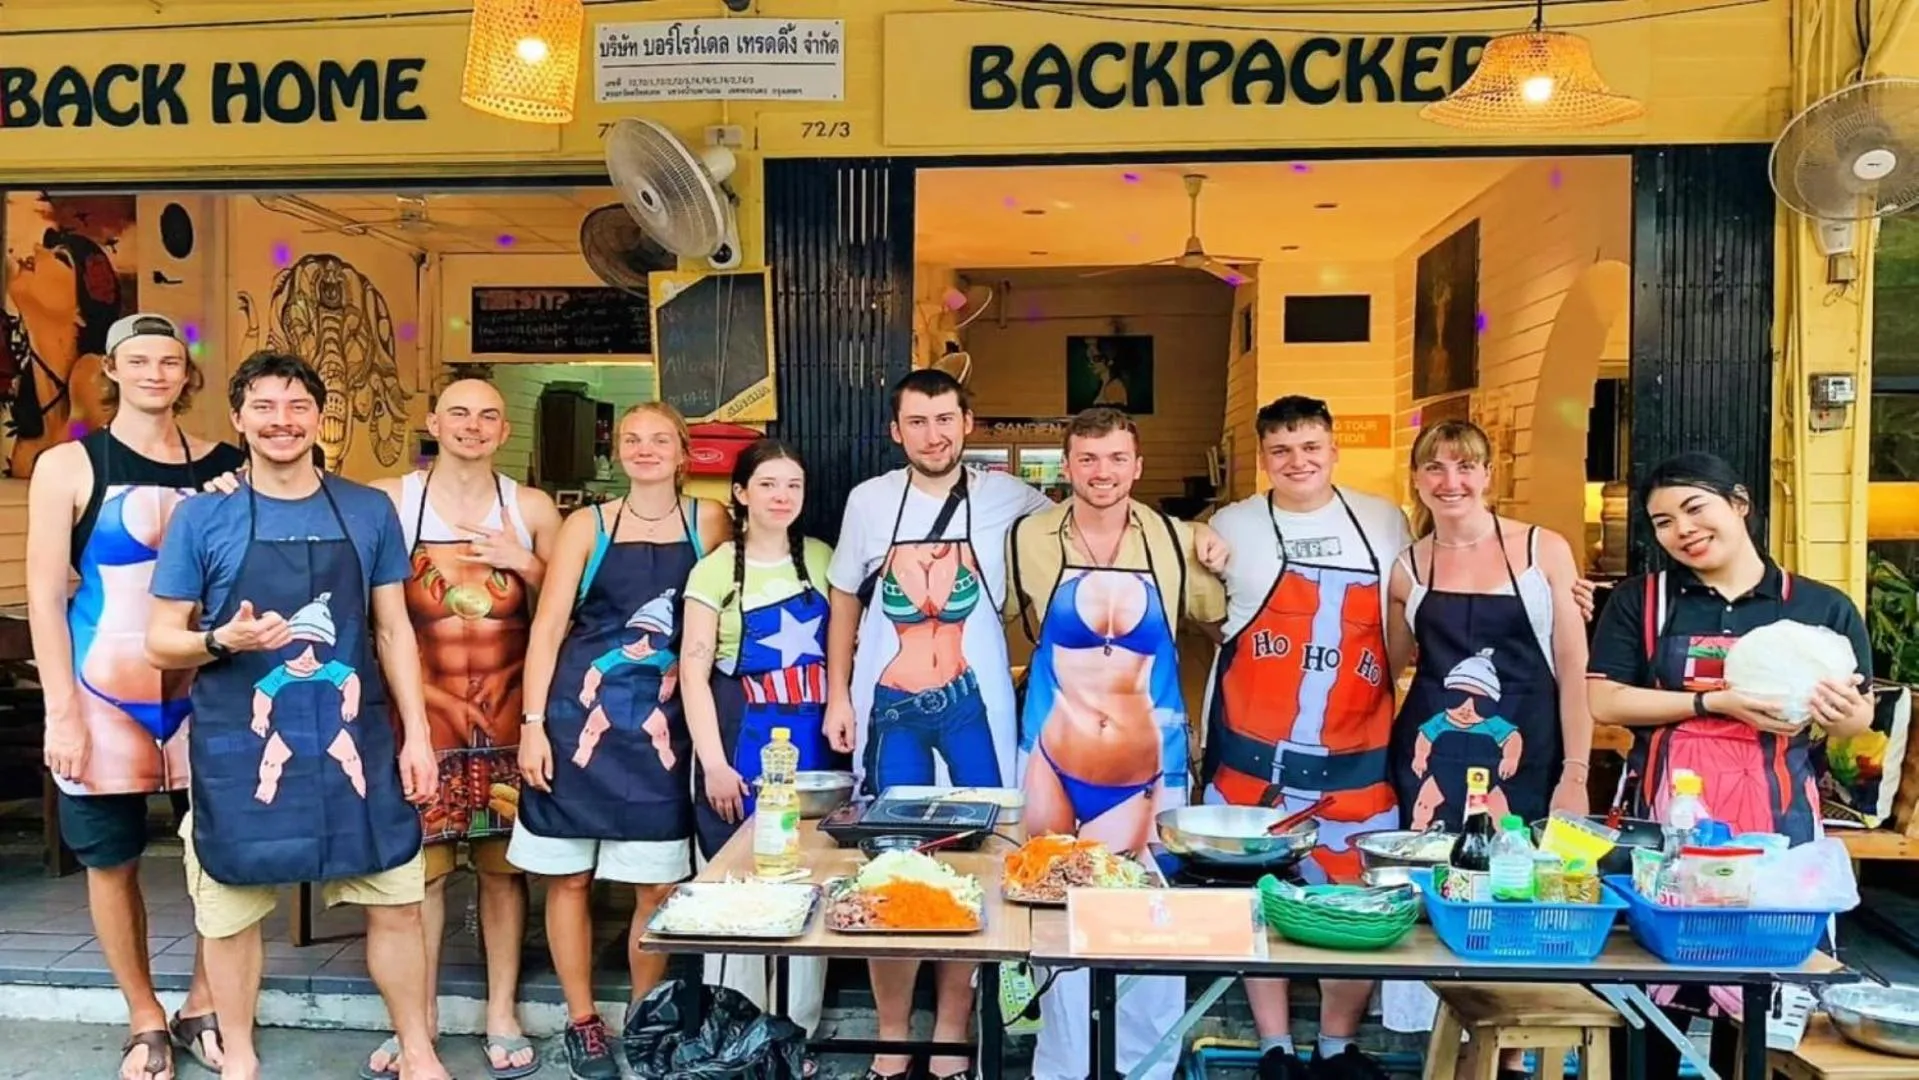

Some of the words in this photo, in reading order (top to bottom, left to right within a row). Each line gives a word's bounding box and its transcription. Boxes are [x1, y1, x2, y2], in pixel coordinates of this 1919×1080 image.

[600, 34, 638, 57] บริษัท
[804, 30, 839, 53] จำกัด
[0, 63, 188, 127] BACK
[212, 58, 427, 122] HOME
[802, 121, 849, 138] 72/3
